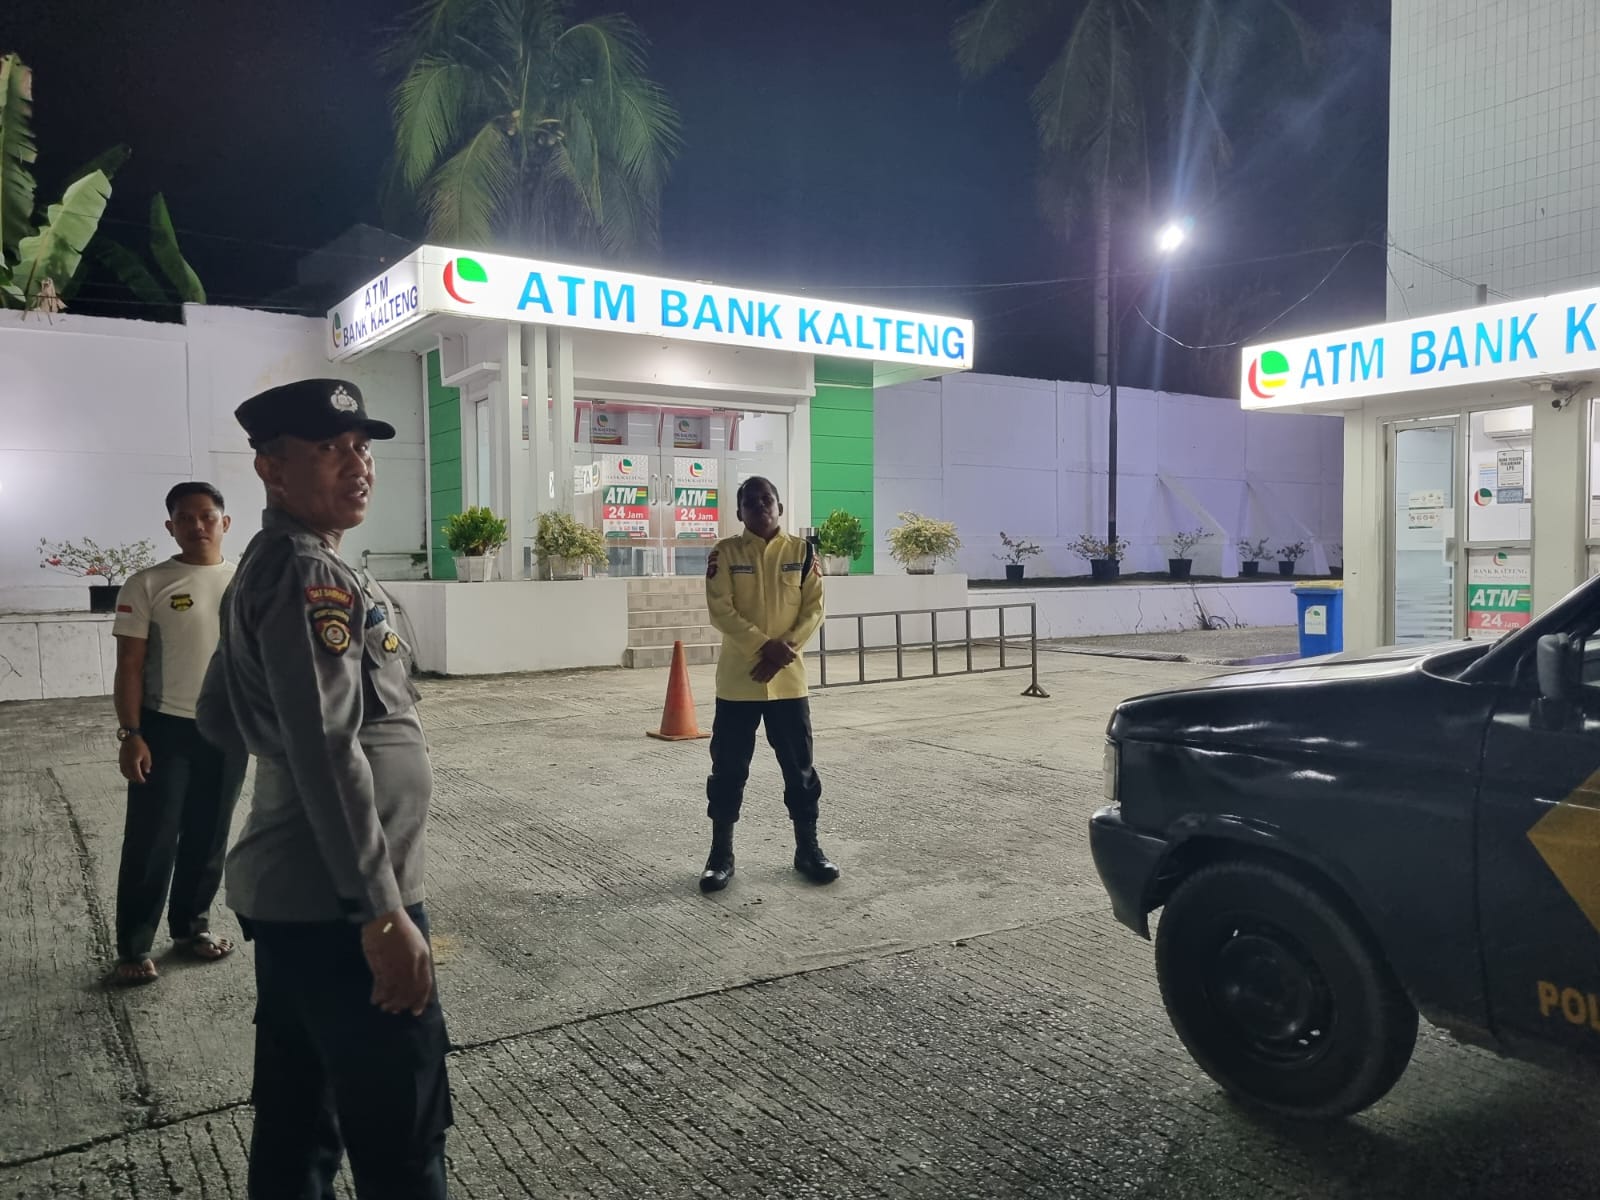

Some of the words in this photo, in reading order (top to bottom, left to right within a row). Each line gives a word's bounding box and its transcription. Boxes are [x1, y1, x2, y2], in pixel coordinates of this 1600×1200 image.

[365, 276, 388, 308] ATM
[343, 314, 368, 347] BANK
[371, 285, 418, 332] KALTENG
[517, 271, 635, 323] ATM
[661, 288, 783, 339] BANK
[798, 307, 965, 360] KALTENG
[1300, 338, 1384, 389] ATM
[1410, 313, 1538, 375] BANK
[1565, 303, 1598, 354] K
[605, 486, 638, 505] ATM
[677, 489, 707, 507] ATM
[608, 506, 626, 519] 24
[627, 511, 644, 519] Jam
[680, 508, 696, 520] 24
[1470, 588, 1519, 607] ATM
[1480, 613, 1503, 627] 24
